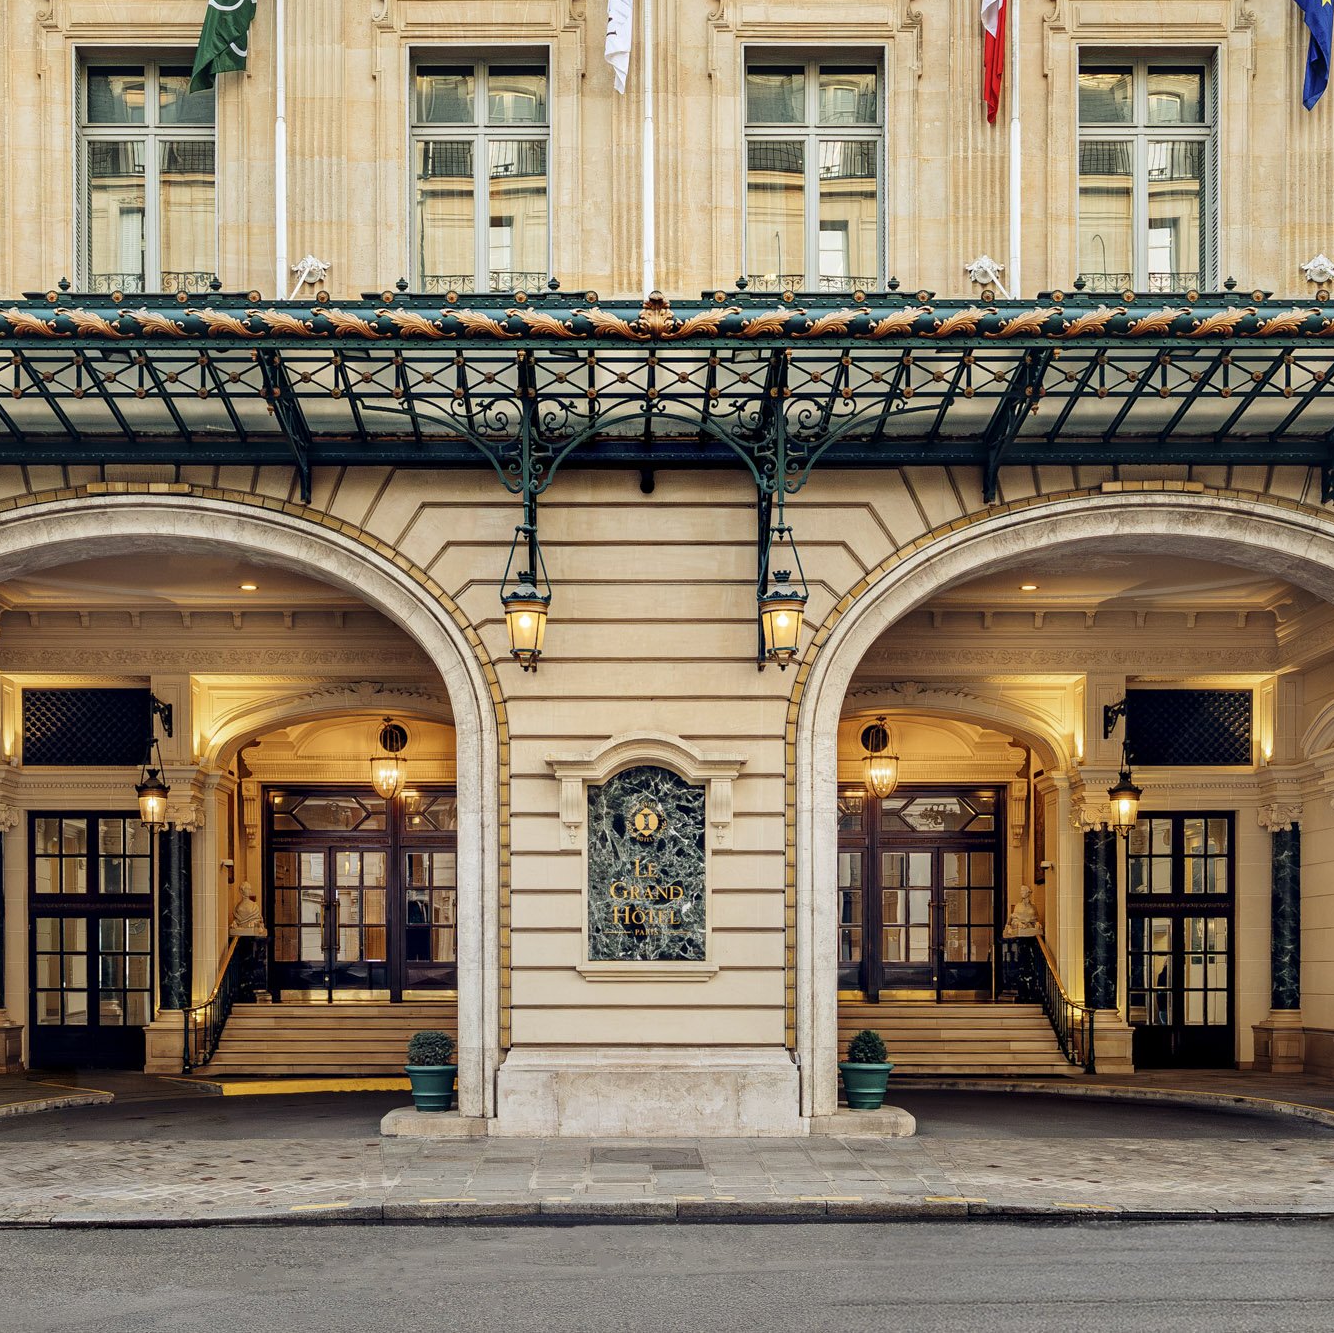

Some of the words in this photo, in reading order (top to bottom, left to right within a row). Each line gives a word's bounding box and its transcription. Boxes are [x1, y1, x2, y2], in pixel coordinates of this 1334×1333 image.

[609, 881, 684, 900] GRAND
[612, 905, 681, 925] HÔTEL
[634, 928, 659, 936] PARIS
